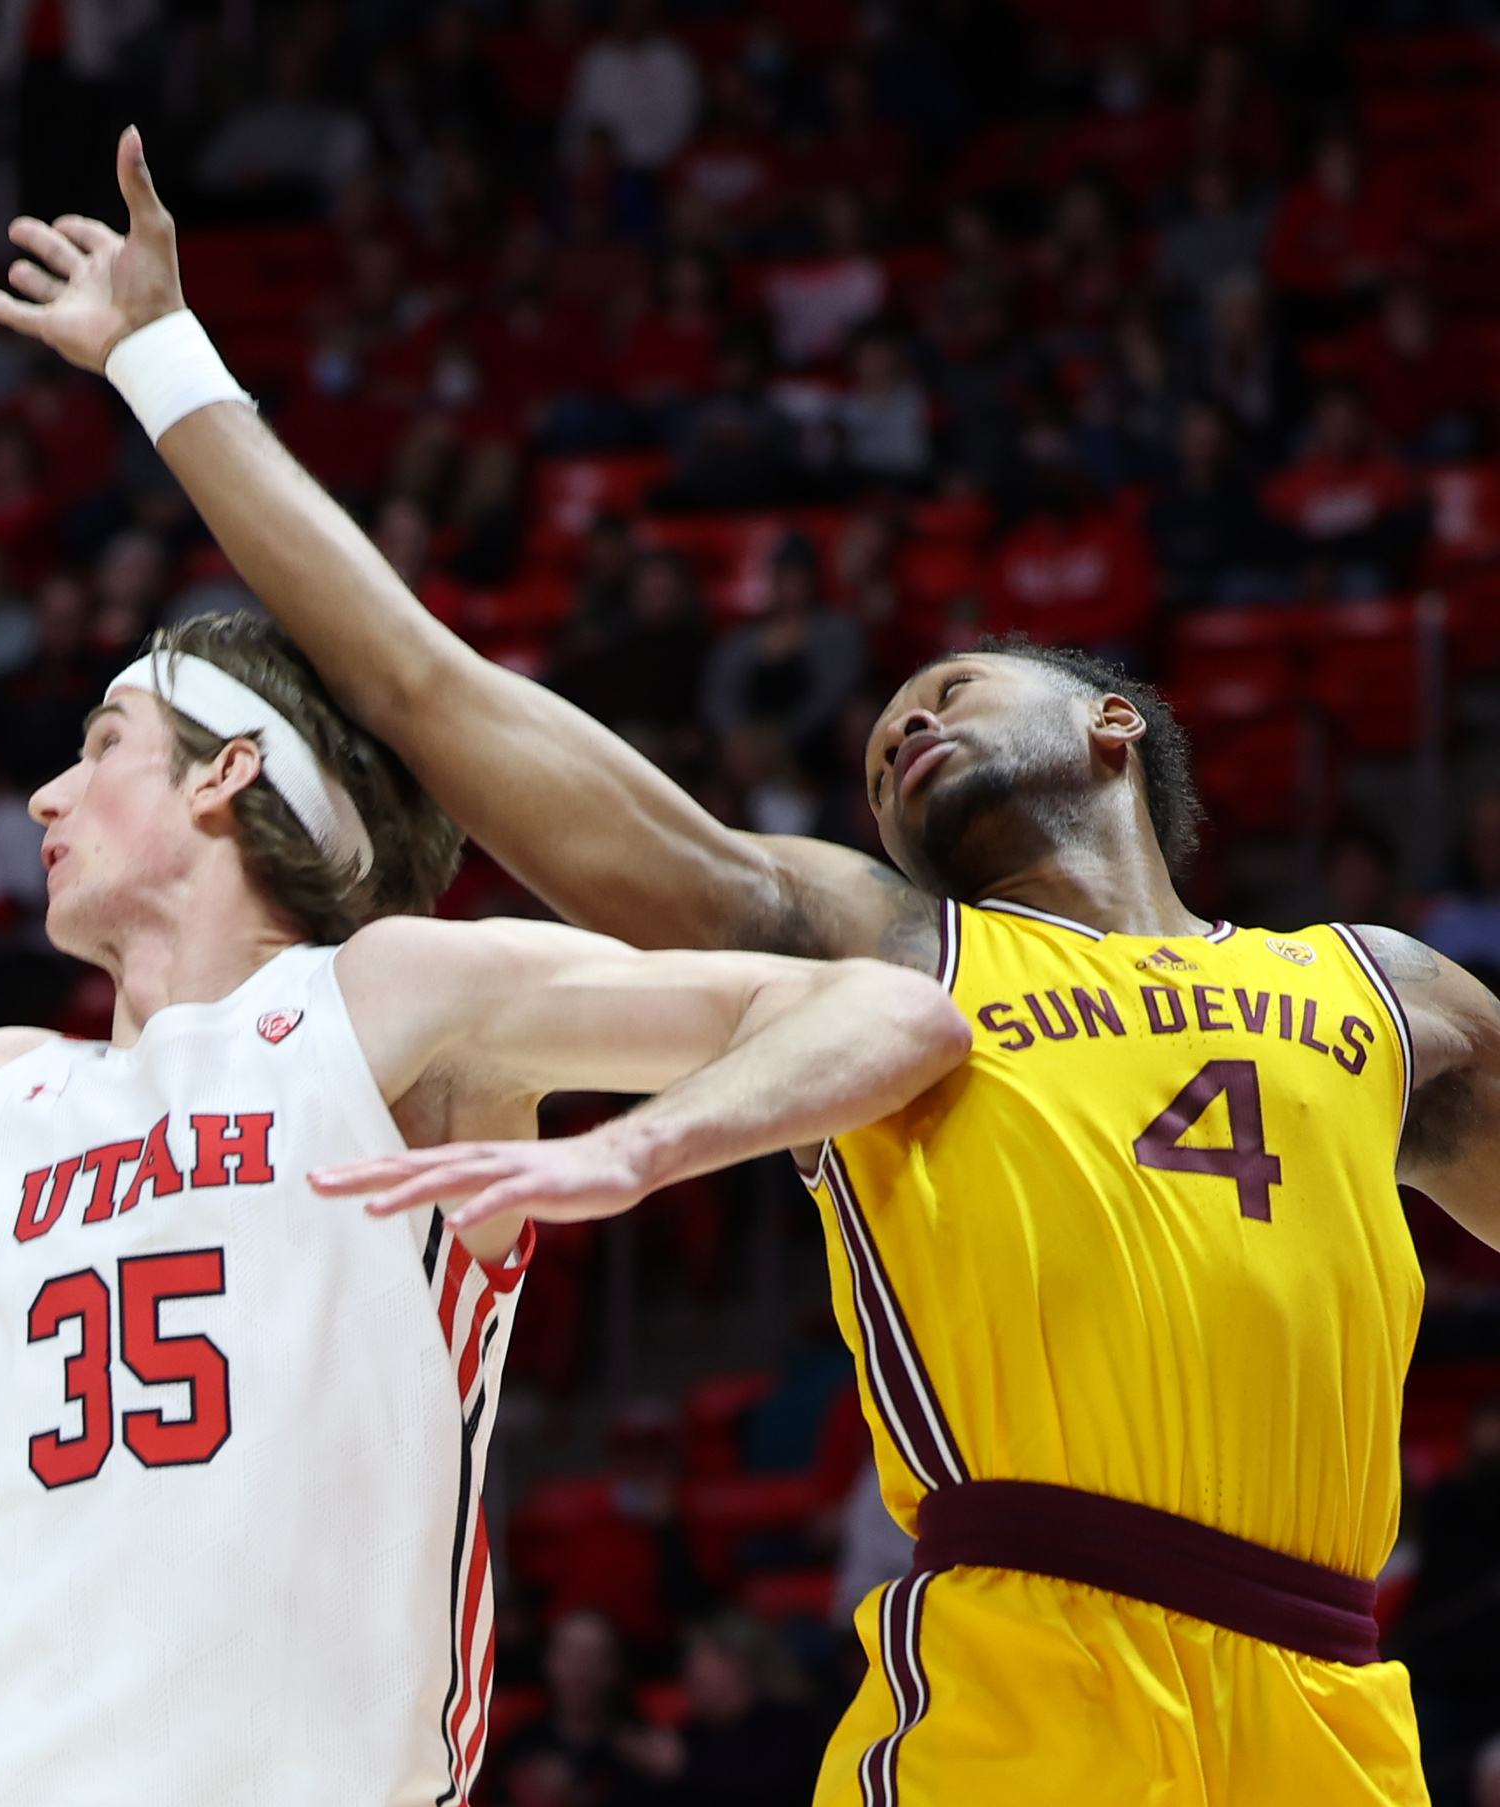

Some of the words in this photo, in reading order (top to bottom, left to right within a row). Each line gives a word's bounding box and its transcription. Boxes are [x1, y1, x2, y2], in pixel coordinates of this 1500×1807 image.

[978, 986, 1126, 1051] SUN
[1140, 984, 1375, 1075] DEVILS
[13, 1111, 275, 1243] UTAH
[1132, 1059, 1282, 1223] 4
[27, 1246, 231, 1490] 35
